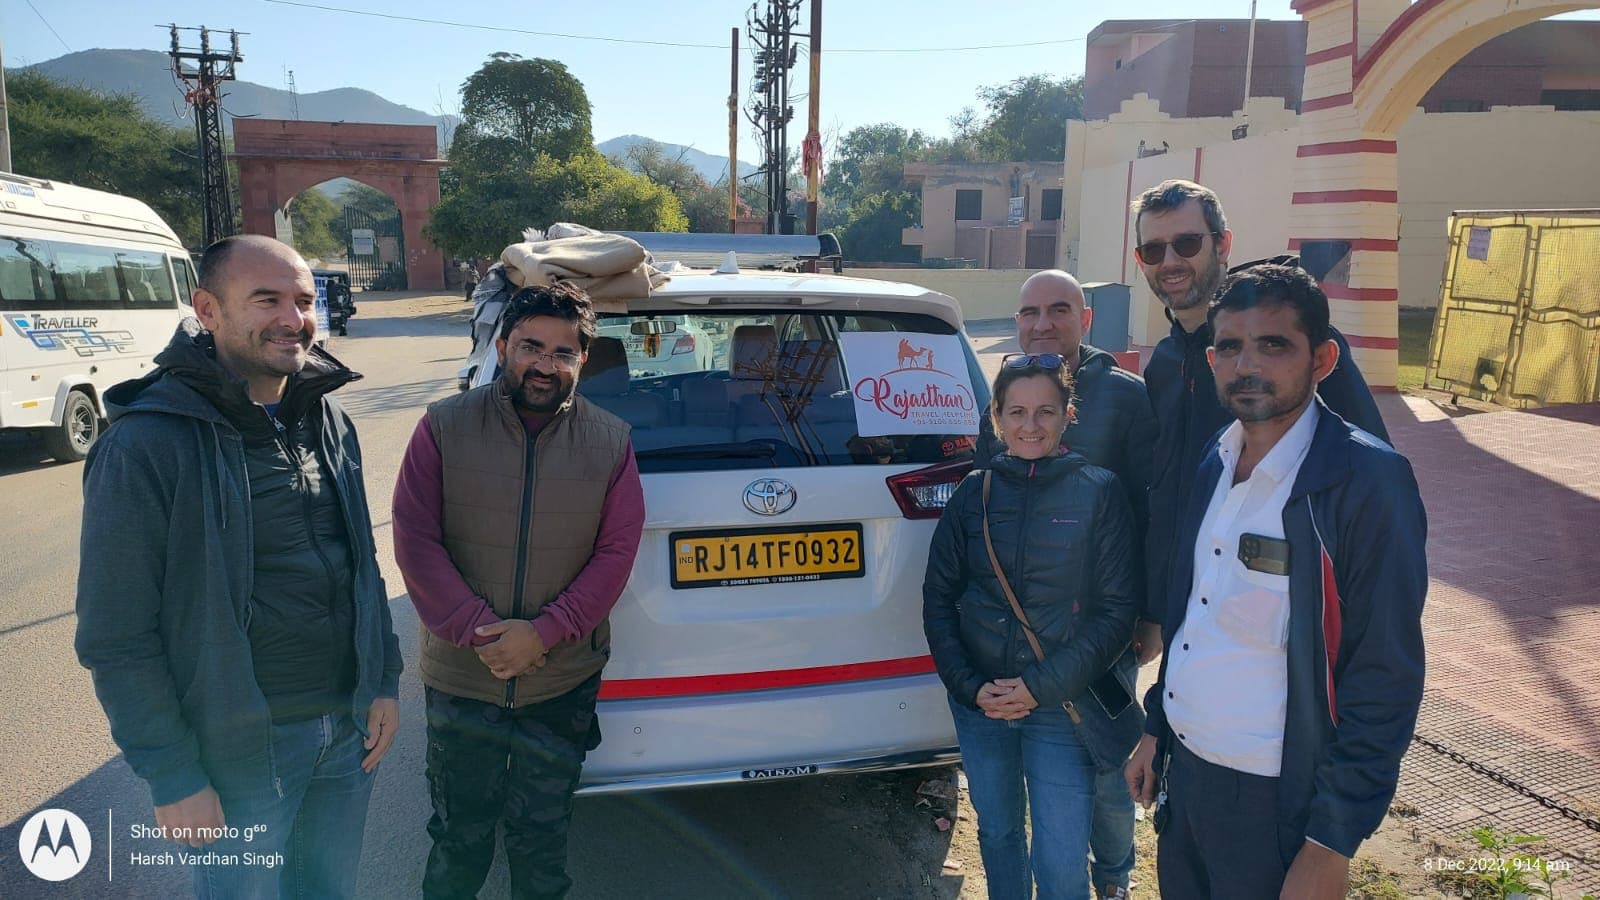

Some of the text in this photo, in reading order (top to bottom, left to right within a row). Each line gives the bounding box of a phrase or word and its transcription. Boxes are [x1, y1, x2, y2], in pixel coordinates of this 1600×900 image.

[31, 314, 98, 329] TRAVELLER
[855, 377, 974, 419] Rajasthan
[679, 556, 694, 564] IND
[695, 538, 856, 573] RJ14TF0932
